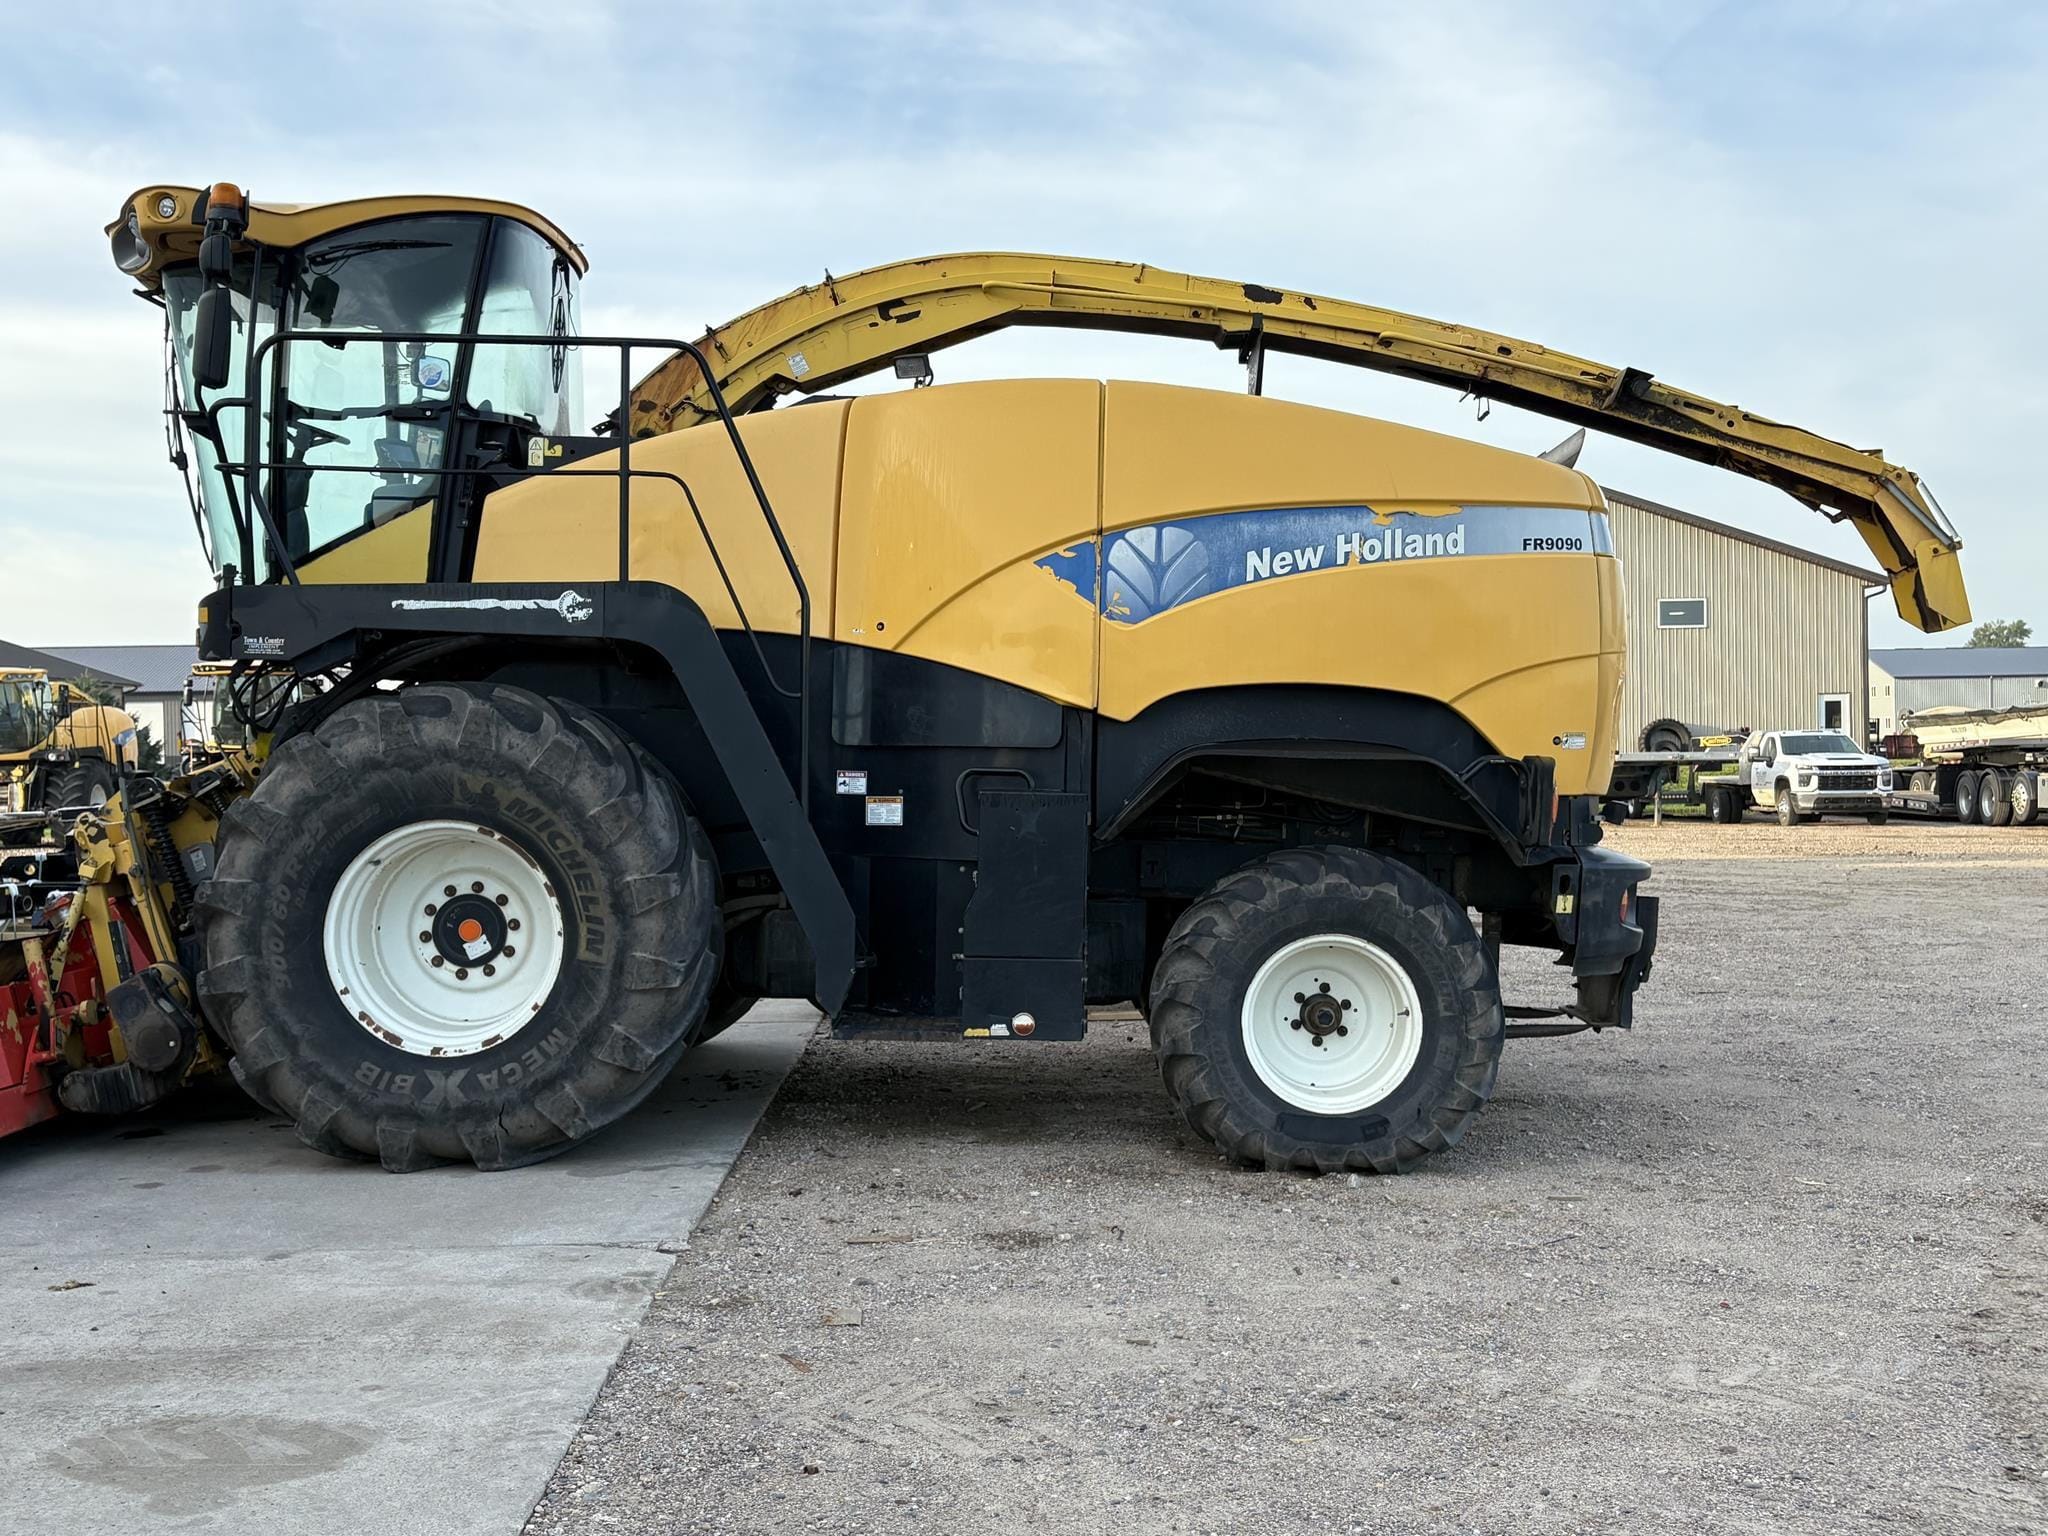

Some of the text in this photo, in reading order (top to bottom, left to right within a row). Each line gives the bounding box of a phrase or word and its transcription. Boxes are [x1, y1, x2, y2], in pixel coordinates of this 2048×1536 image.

[1245, 524, 1465, 582] New Holland
[1522, 537, 1583, 551] FR9090
[264, 636, 286, 645] Country
[505, 796, 606, 958] MICHELIN
